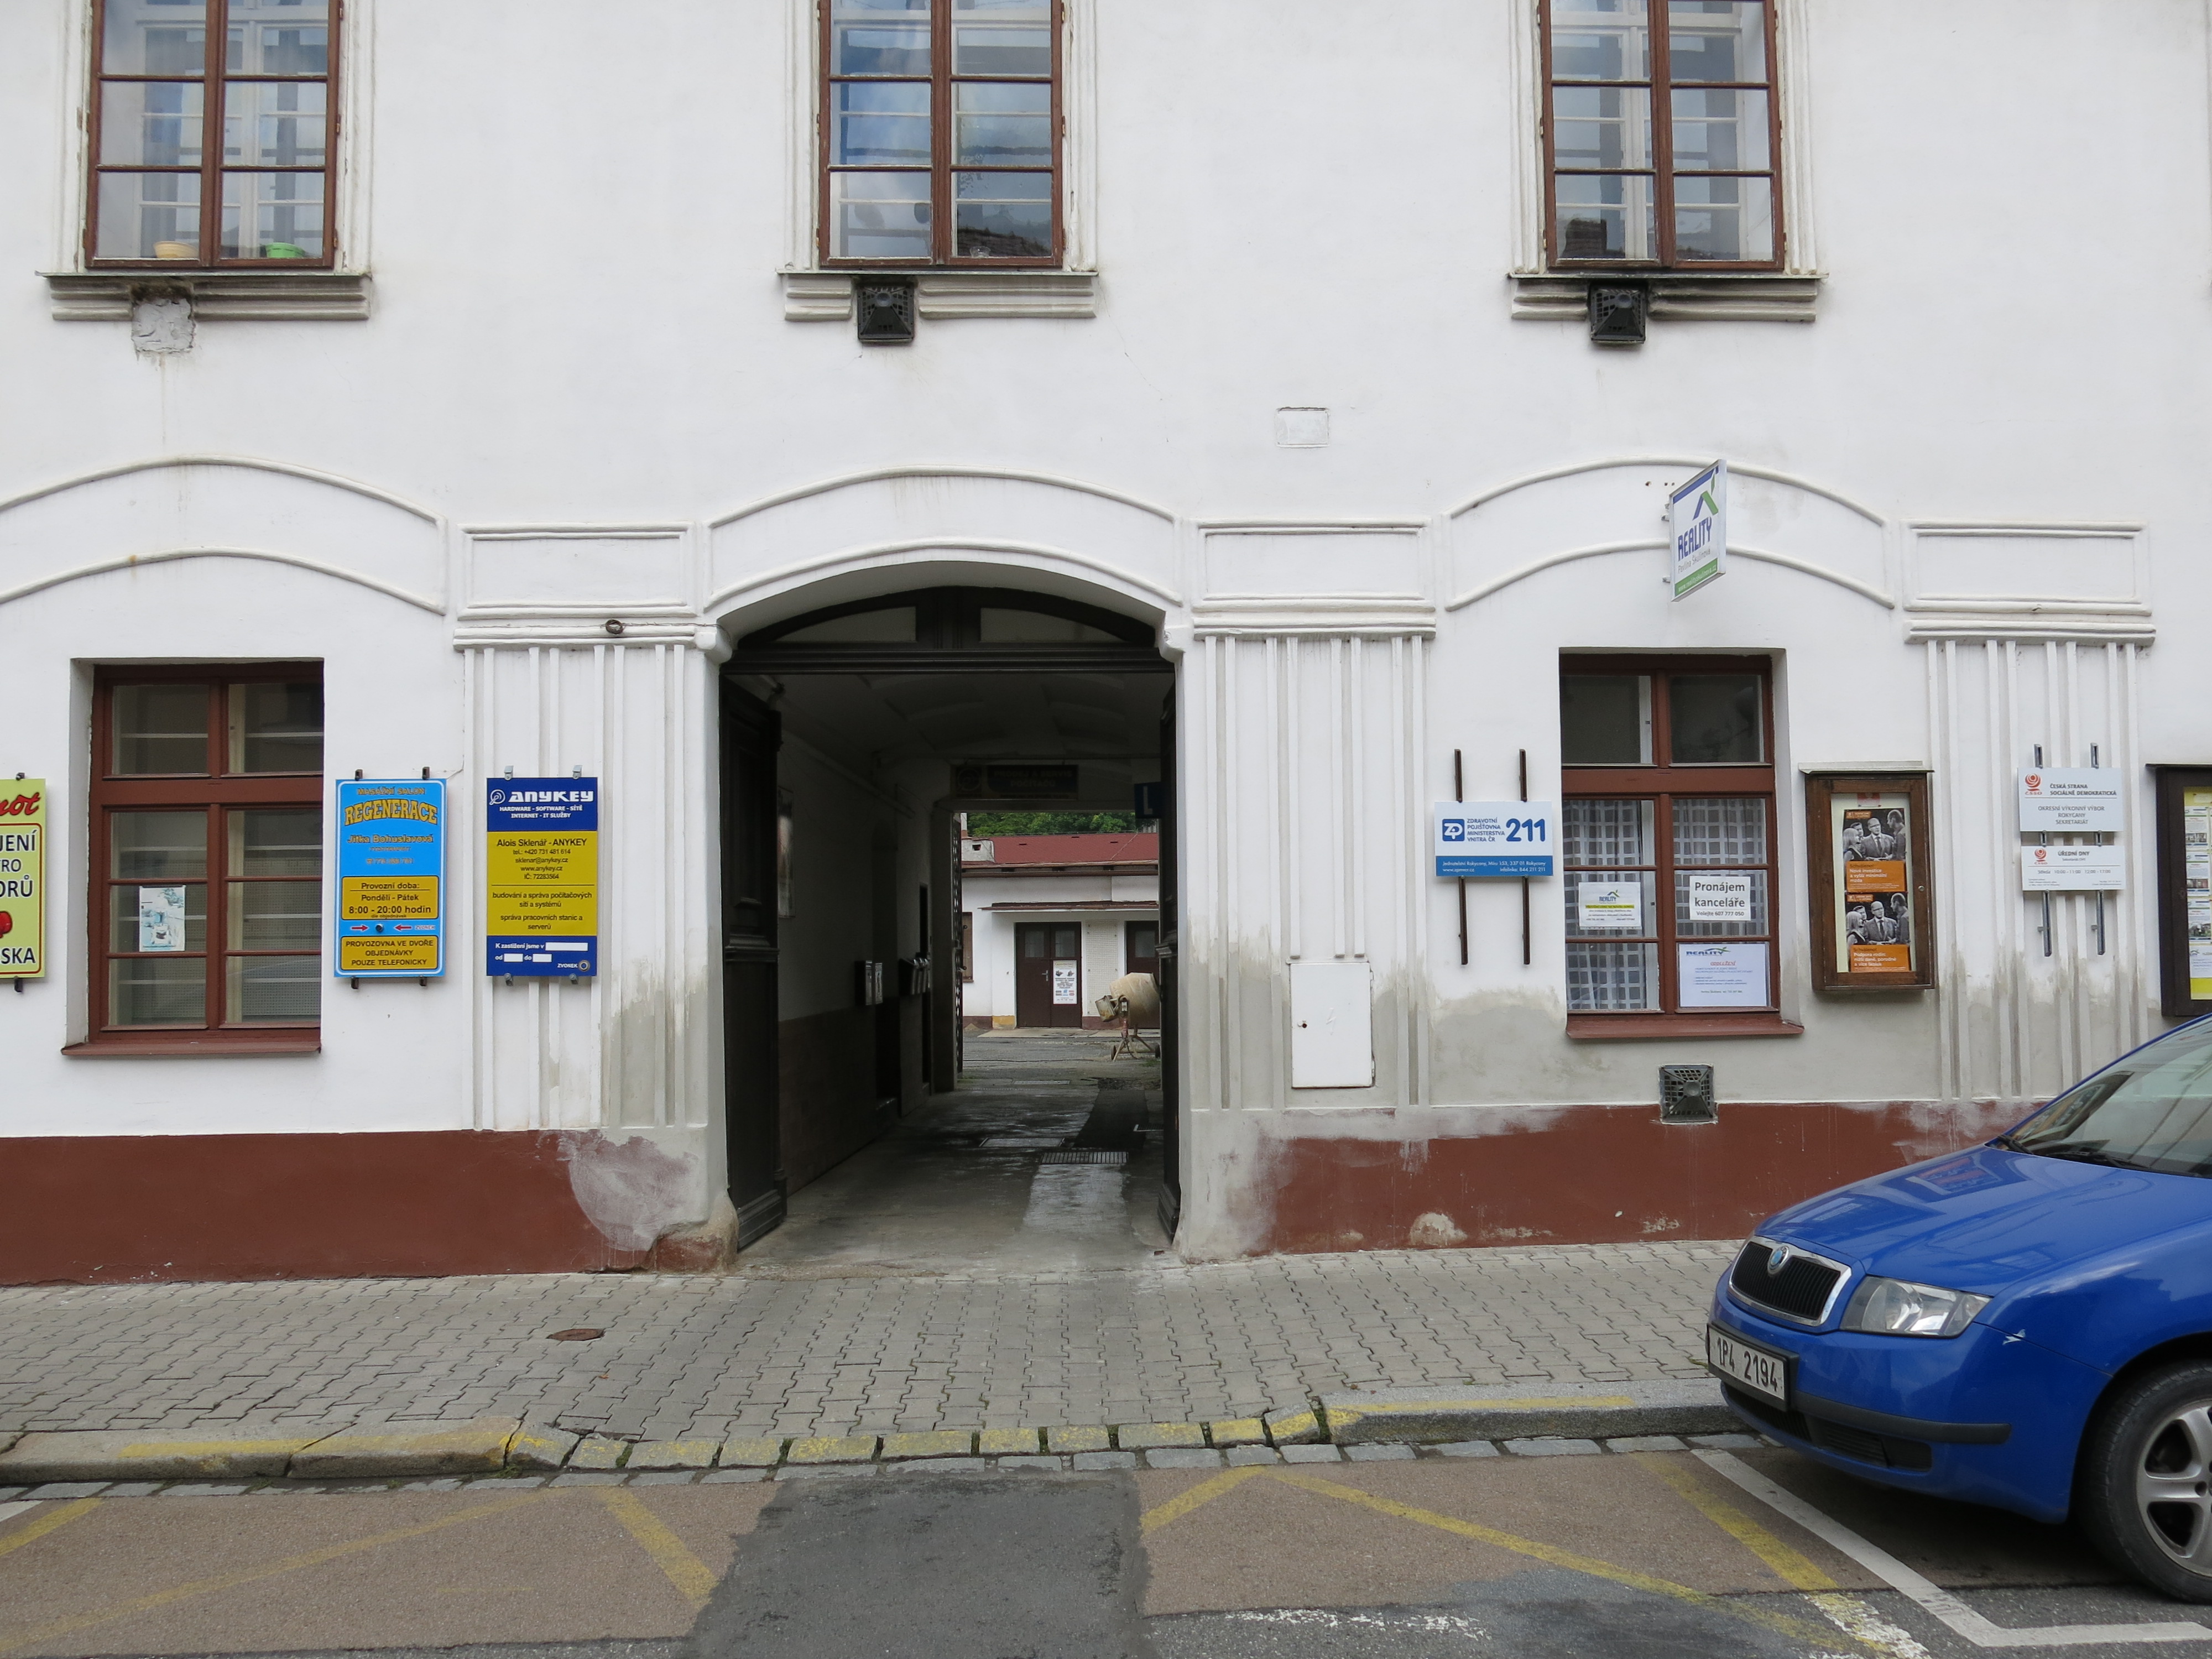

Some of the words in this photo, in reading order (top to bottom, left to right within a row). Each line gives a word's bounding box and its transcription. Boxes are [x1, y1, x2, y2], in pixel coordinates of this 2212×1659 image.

[1678, 517, 1712, 561] REALITY
[345, 799, 438, 826] REGENERACE
[1506, 818, 1546, 842] 211
[347, 834, 370, 843] Jitka
[373, 834, 433, 843] Bohuslavová
[0, 858, 22, 872] RO
[1695, 882, 1745, 893] Pronájem
[551, 891, 592, 900] počítačových
[1694, 897, 1745, 907] kanceláře
[1717, 1337, 1735, 1372] 1P4
[1744, 1350, 1777, 1392] 2194
